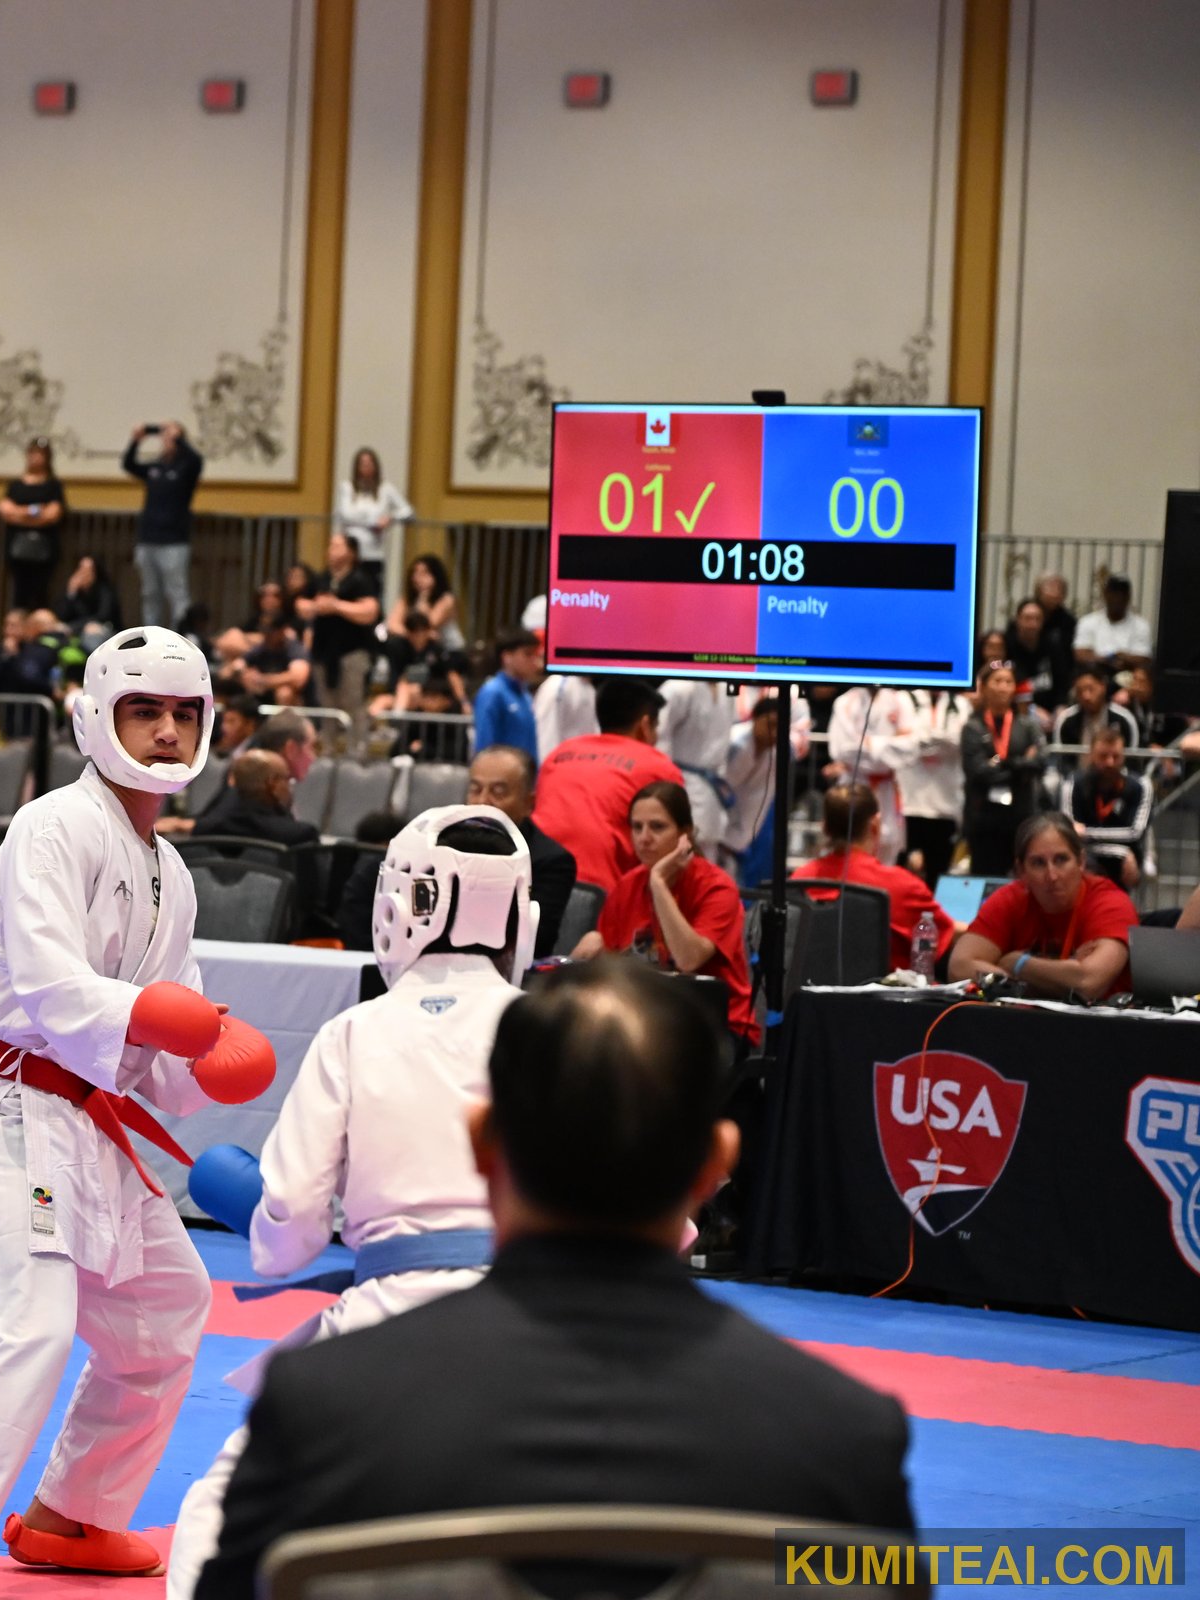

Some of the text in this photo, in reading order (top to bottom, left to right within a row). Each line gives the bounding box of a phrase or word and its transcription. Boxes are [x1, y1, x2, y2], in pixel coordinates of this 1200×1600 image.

[599, 472, 664, 533] 01
[829, 476, 905, 539] 00
[701, 542, 805, 582] 01:08
[550, 588, 610, 611] Penalty
[767, 595, 828, 618] Penalty
[890, 1073, 1002, 1138] USA
